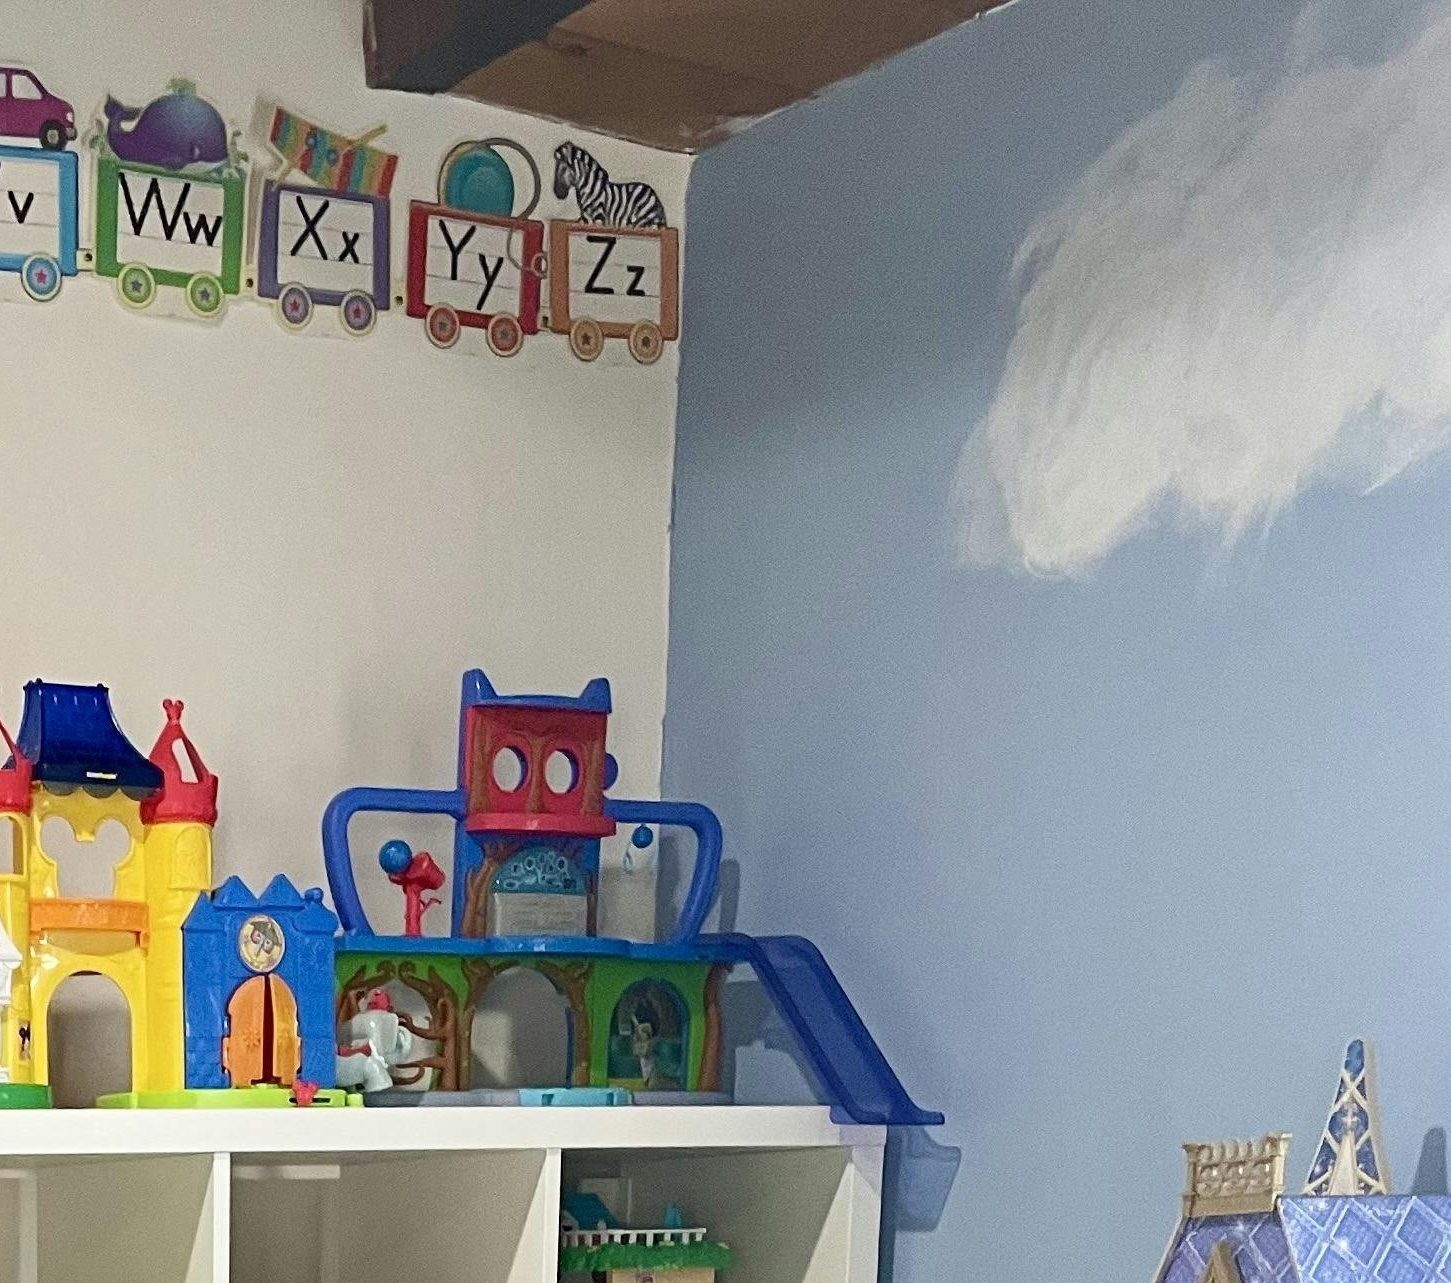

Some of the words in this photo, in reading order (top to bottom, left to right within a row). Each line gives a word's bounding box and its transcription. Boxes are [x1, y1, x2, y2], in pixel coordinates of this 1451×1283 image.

[118, 172, 223, 247] Ww
[290, 196, 360, 264] Xx
[439, 220, 504, 311] Yy
[584, 235, 646, 298] Zz
